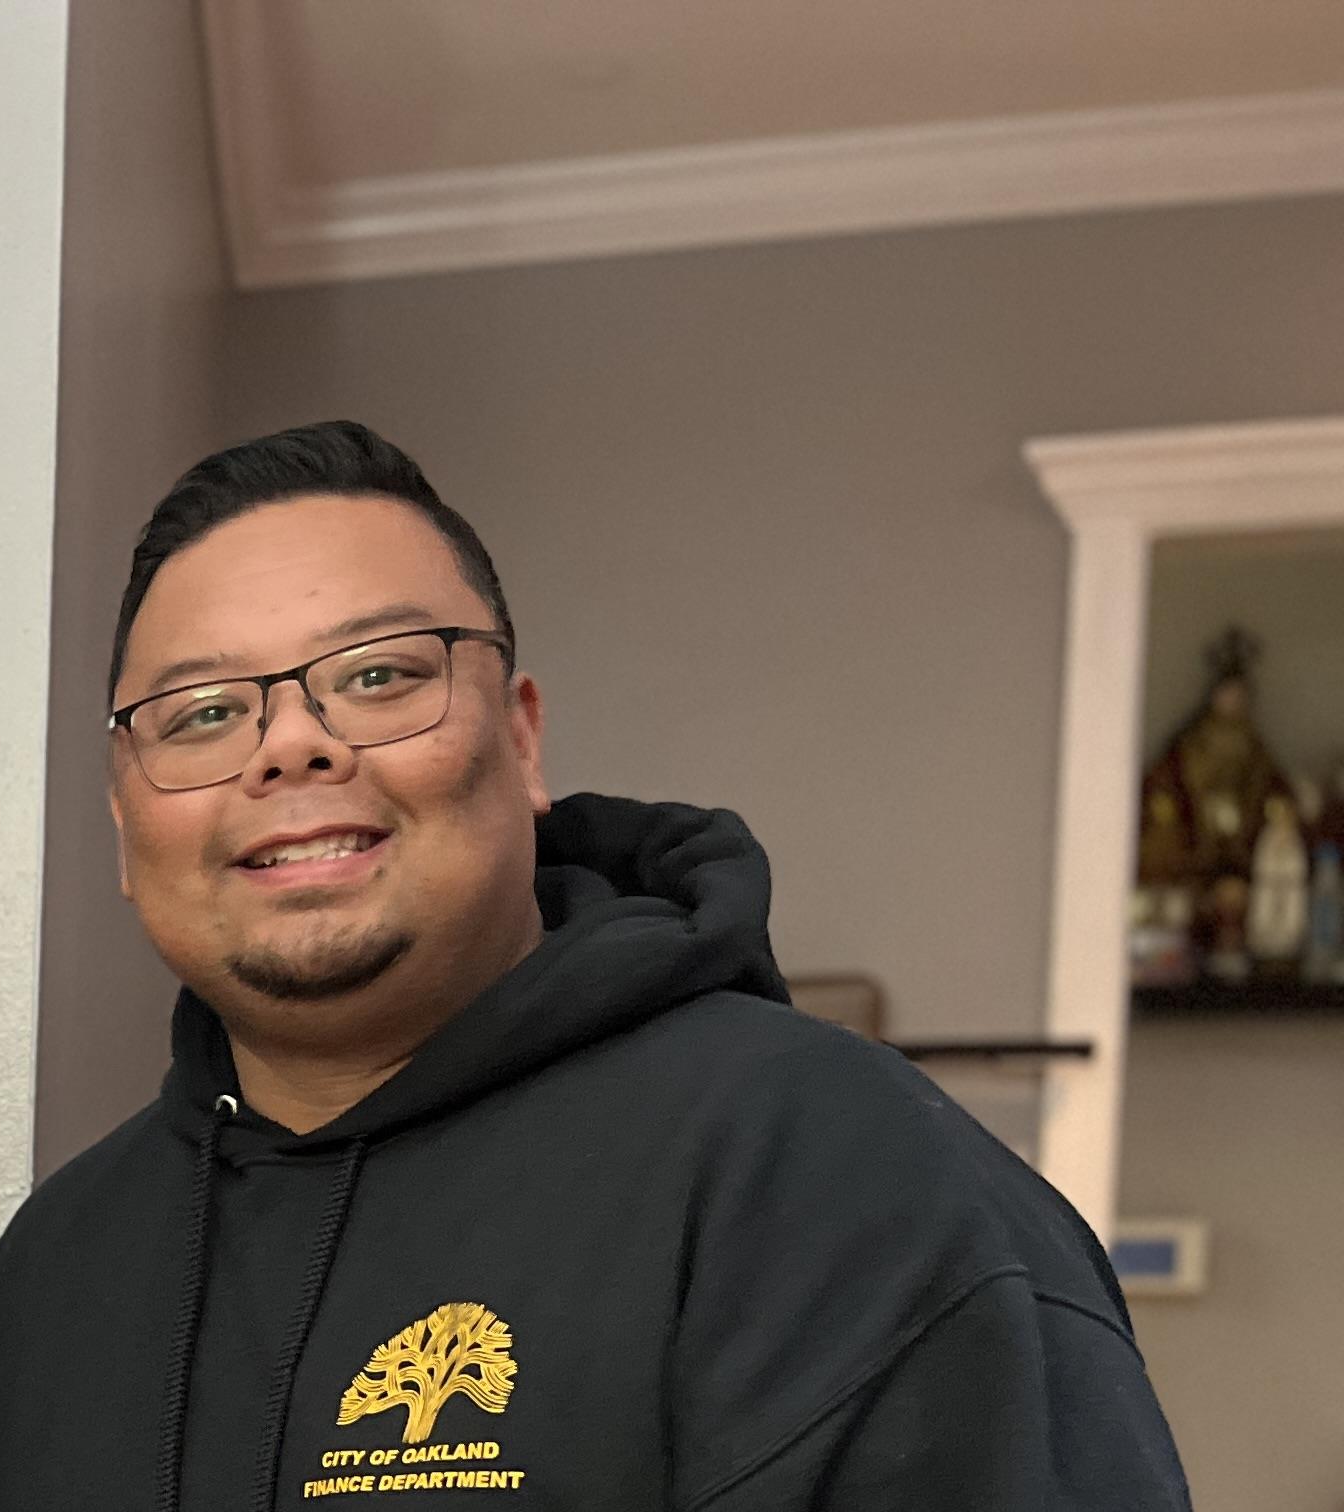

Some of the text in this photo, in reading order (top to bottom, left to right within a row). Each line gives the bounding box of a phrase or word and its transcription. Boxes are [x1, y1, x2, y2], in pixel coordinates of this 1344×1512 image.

[322, 1442, 499, 1467] CITY OF OAKLAND
[304, 1471, 524, 1498] FINANCE DEPARTMENT
